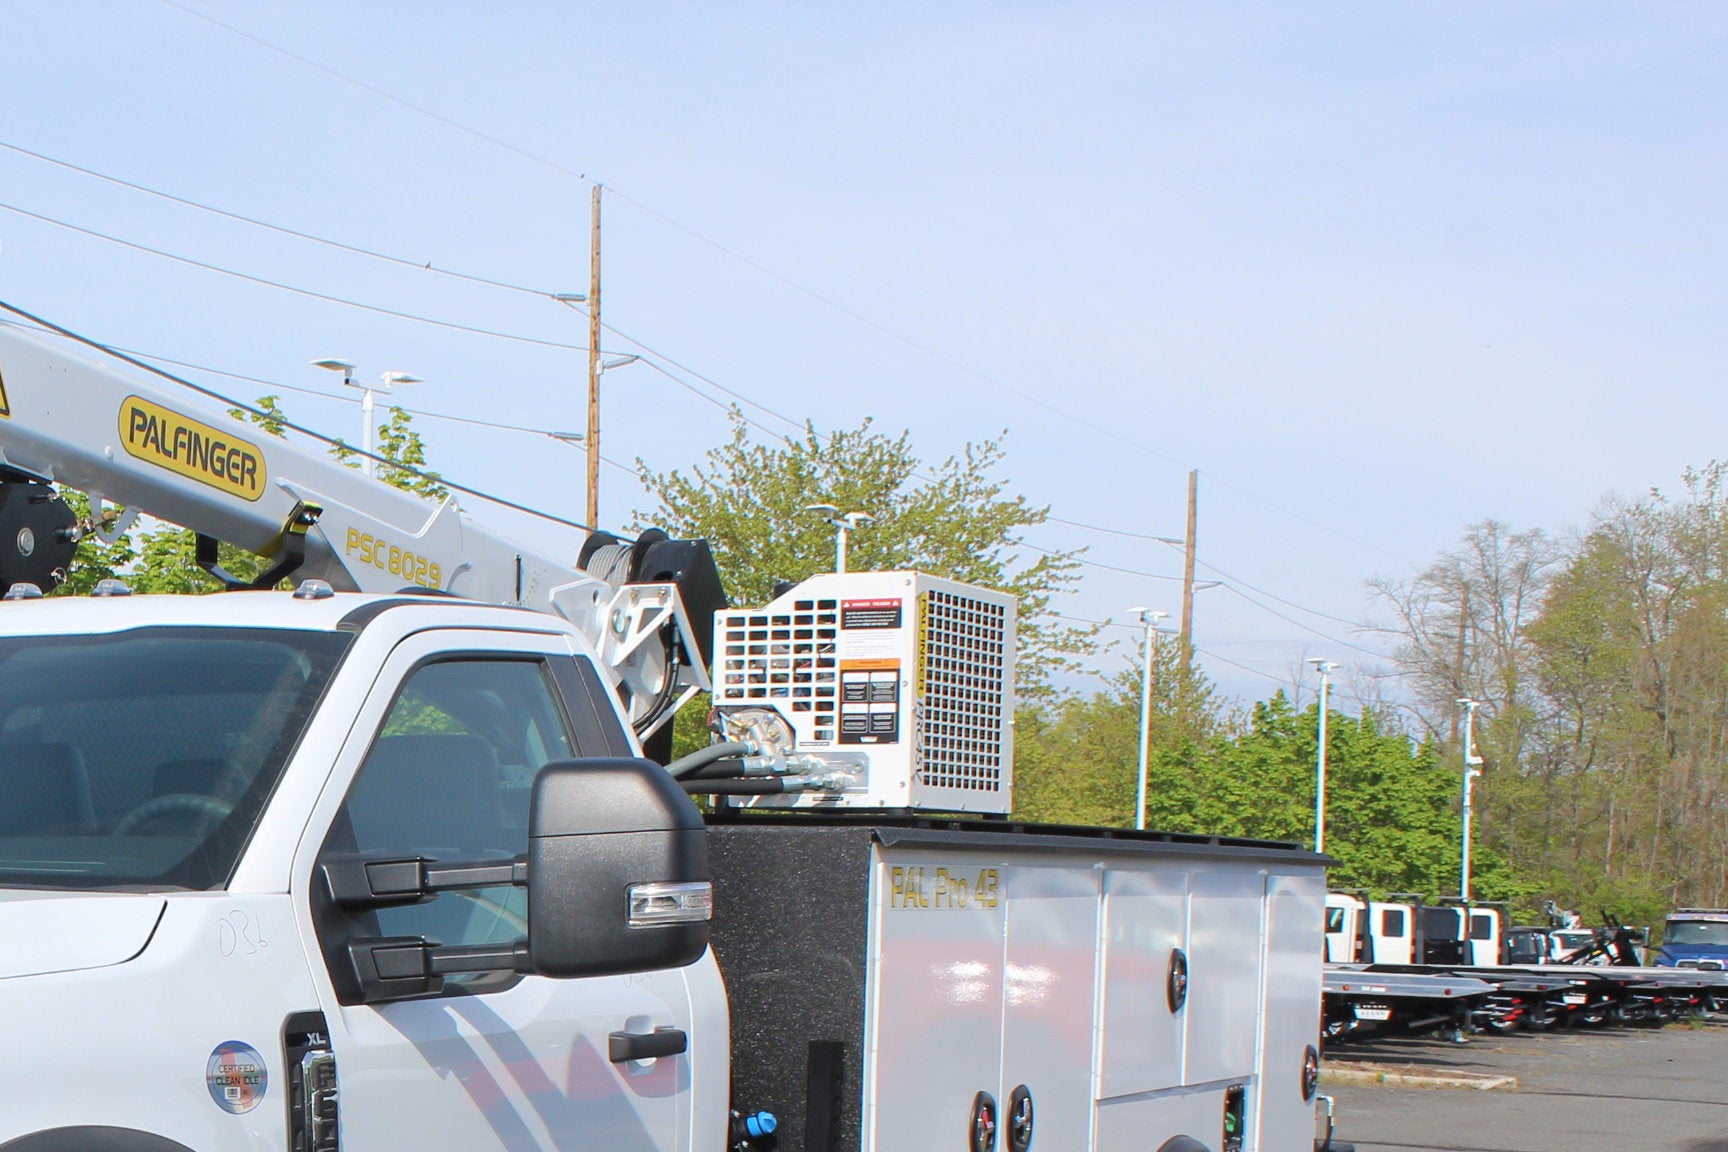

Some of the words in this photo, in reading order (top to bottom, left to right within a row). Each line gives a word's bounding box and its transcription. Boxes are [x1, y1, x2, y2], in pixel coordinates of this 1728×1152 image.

[129, 406, 257, 491] PALFINGER
[346, 526, 387, 570] PSC
[388, 545, 442, 590] 8029
[891, 867, 928, 907] PAL
[935, 867, 968, 907] Pro
[974, 868, 998, 907] 43
[306, 1032, 326, 1046] XL
[215, 1076, 241, 1086] CLEAN
[243, 1075, 260, 1085] IDLE
[218, 1064, 255, 1074] CERTIFIED
